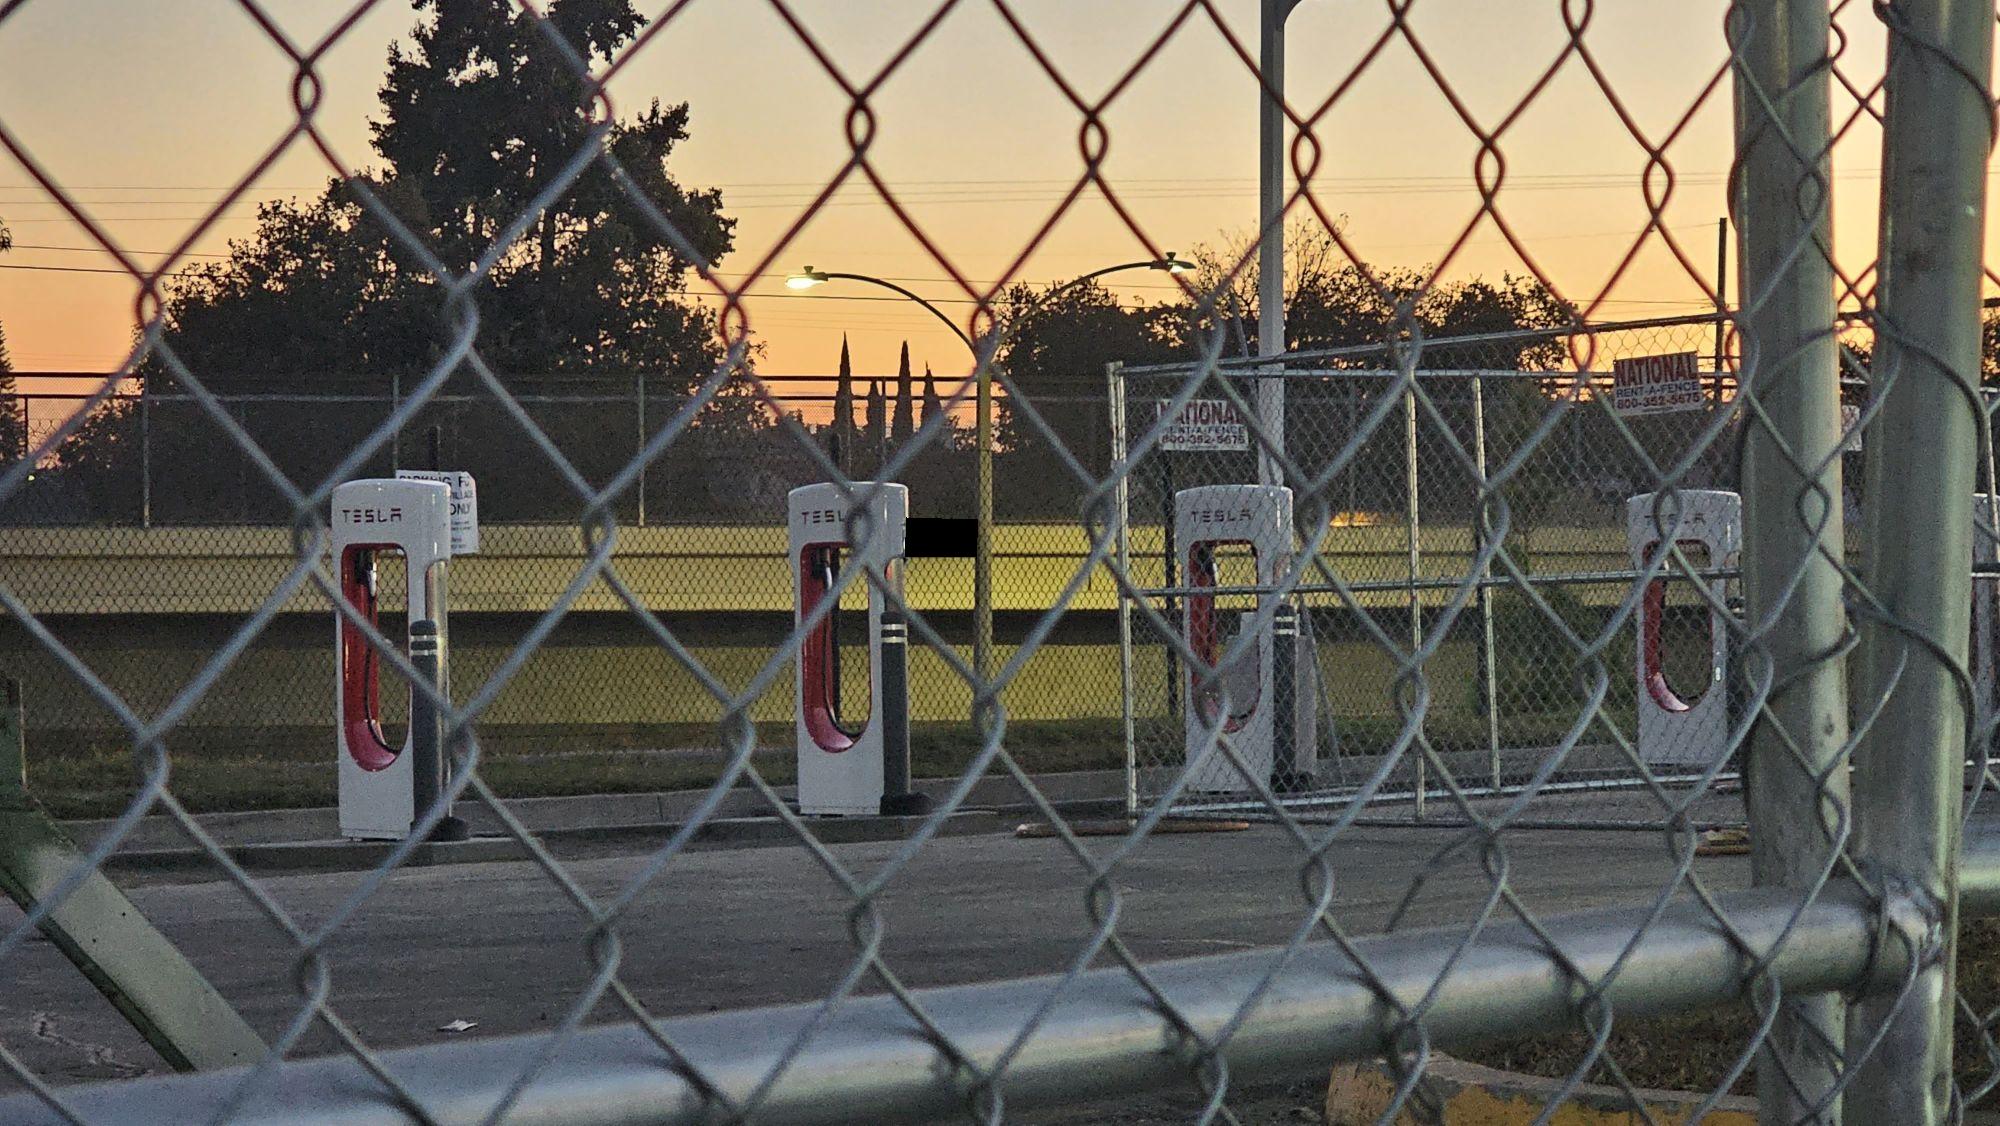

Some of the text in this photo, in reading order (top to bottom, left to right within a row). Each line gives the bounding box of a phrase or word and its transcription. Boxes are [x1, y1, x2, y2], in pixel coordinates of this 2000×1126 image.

[1614, 353, 1698, 387] NATIONAL
[342, 508, 402, 523] TESLA
[801, 509, 859, 525] TESL
[1191, 510, 1254, 523] TESLA
